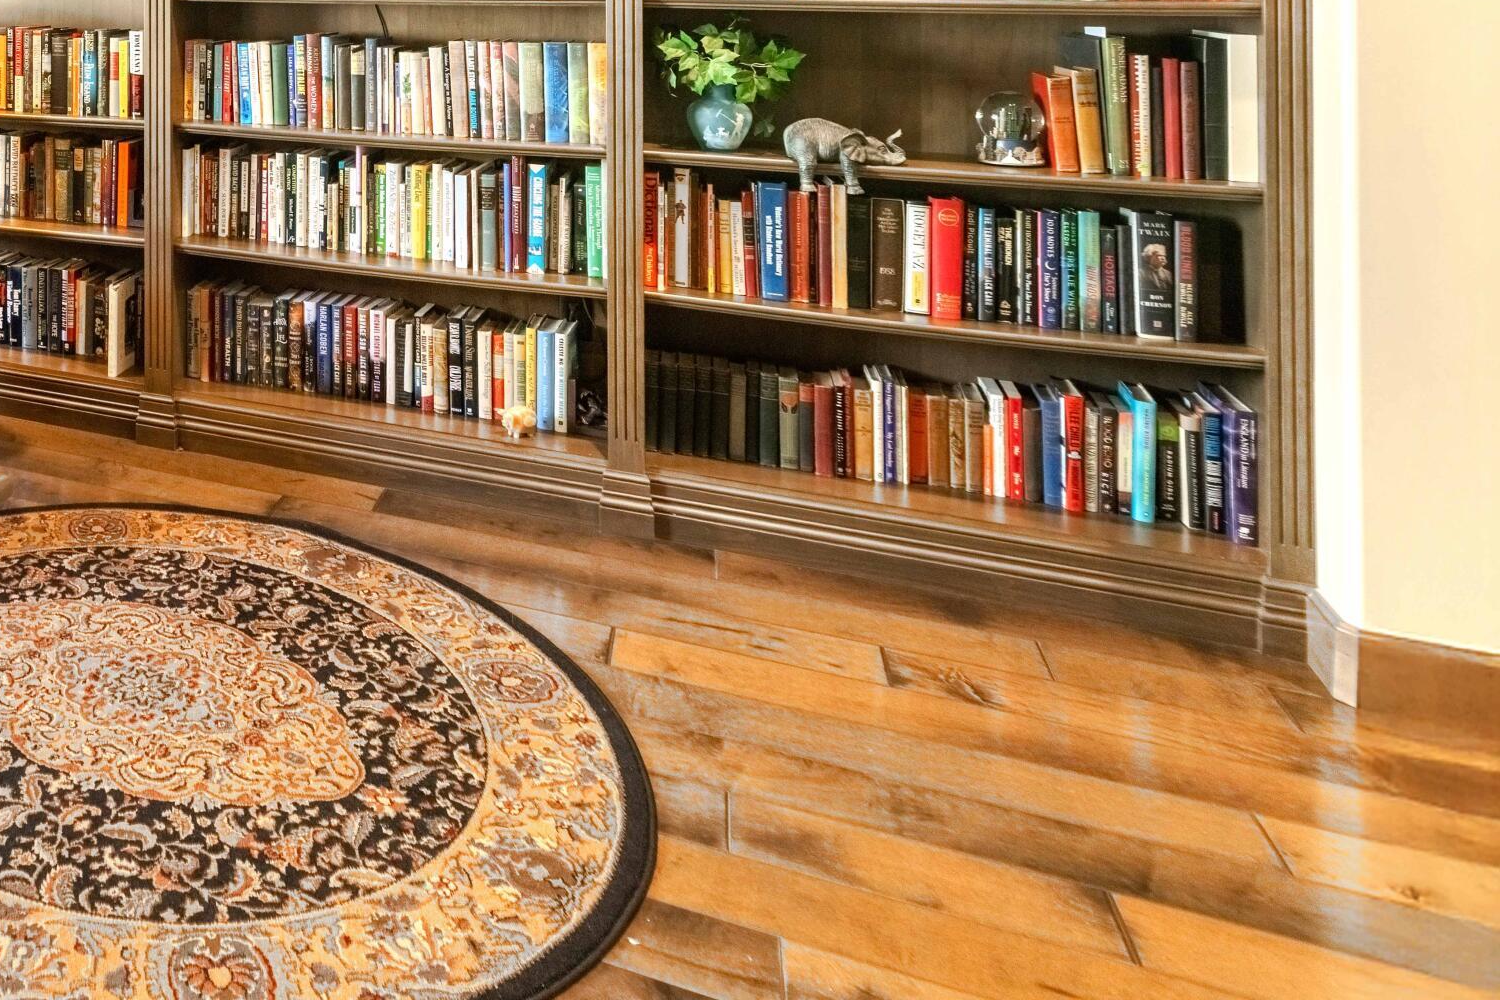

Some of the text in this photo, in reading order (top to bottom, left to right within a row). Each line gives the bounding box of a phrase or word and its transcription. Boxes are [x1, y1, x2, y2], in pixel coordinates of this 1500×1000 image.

[84, 63, 94, 103] PLUM ISLAND
[240, 46, 249, 90] AMERICAN DIRT
[297, 40, 306, 95] LISA SCOTTOLINE
[1118, 44, 1127, 103] ANSEL ADAMS
[11, 140, 19, 159] DAVID
[414, 169, 422, 202] Fulfilling Lives
[644, 177, 658, 247] Dictionary
[775, 207, 783, 276] Webster's New World Dictionary
[913, 210, 926, 269] ROGET A-Z
[1046, 219, 1055, 258] JOJO MOYES
[1138, 229, 1171, 238] TWAIN
[1180, 226, 1194, 253] BLOOD
[984, 213, 993, 306] THE TERMINAL LIST JACK CARR
[1025, 272, 1032, 280] No
[1106, 255, 1115, 298] HOSTAGE
[1043, 287, 1051, 303] Shoes
[1067, 251, 1075, 311] FIRST LIE WINS
[12, 289, 21, 317] Tom Clancy
[320, 306, 328, 355] HARLAN COBEN
[1069, 411, 1081, 448] LEE CHILD
[1239, 419, 1250, 454] ENGLAND
[1101, 472, 1110, 495] RICE
[1239, 461, 1250, 489] Literature
